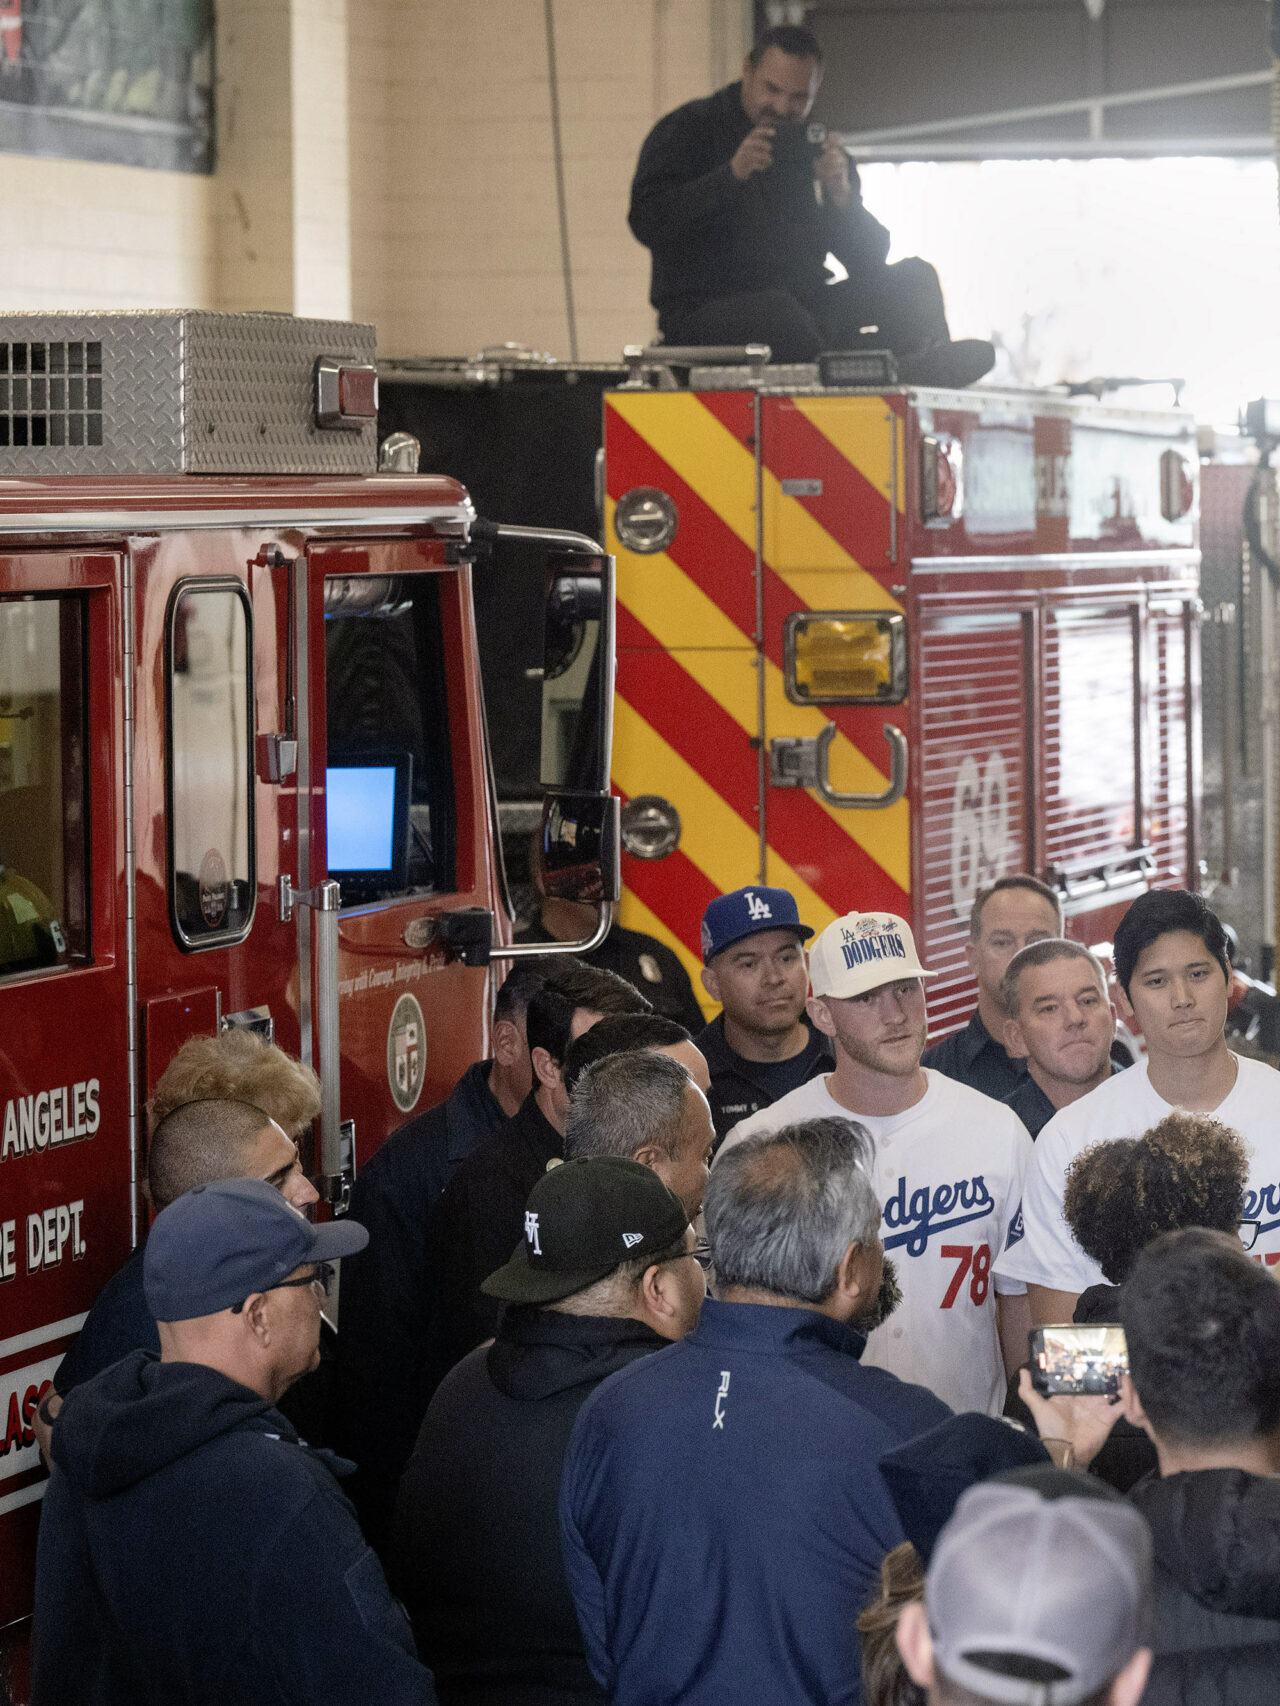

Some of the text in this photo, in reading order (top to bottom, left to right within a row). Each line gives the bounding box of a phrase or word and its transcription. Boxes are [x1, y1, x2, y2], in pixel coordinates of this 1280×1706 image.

[744, 892, 772, 920] LA
[840, 928, 856, 943] LA
[841, 933, 906, 970] DODGERS
[1, 1078, 100, 1158] ANGELES
[27, 1199, 86, 1272] DEPT.
[882, 1175, 994, 1258] dgers
[940, 1244, 991, 1309] 78
[712, 1370, 731, 1430] RLX
